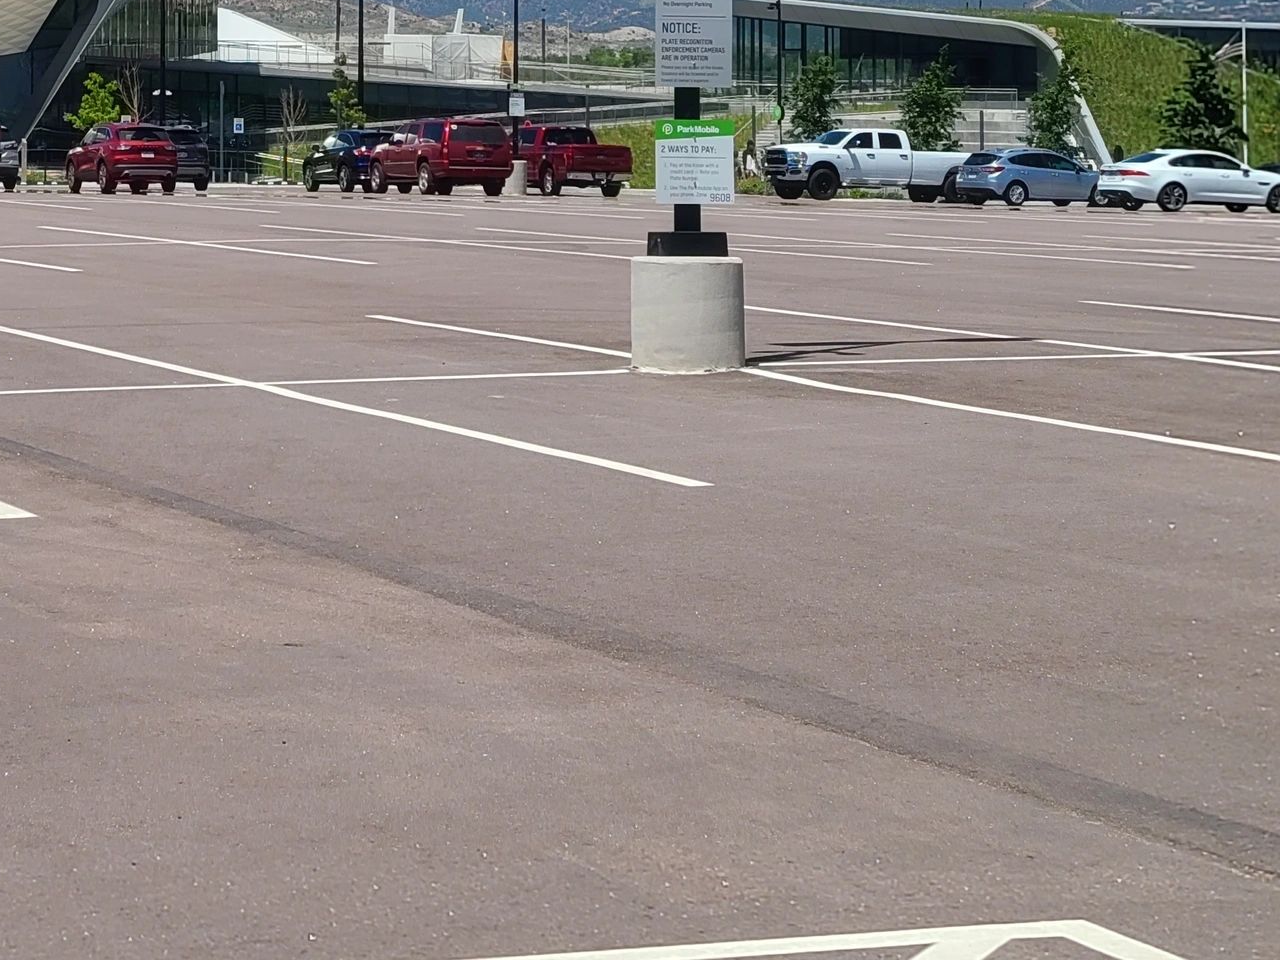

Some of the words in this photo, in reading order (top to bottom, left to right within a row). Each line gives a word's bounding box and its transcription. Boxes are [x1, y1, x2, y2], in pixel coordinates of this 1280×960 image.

[695, 1, 713, 9] Parking
[661, 22, 701, 34] NOTICE:
[676, 125, 720, 134] ParkMobile
[660, 145, 666, 153] 2
[667, 145, 689, 153] WAYS
[690, 145, 700, 153] TO
[701, 145, 717, 154] PAY:
[709, 193, 731, 202] 9608
